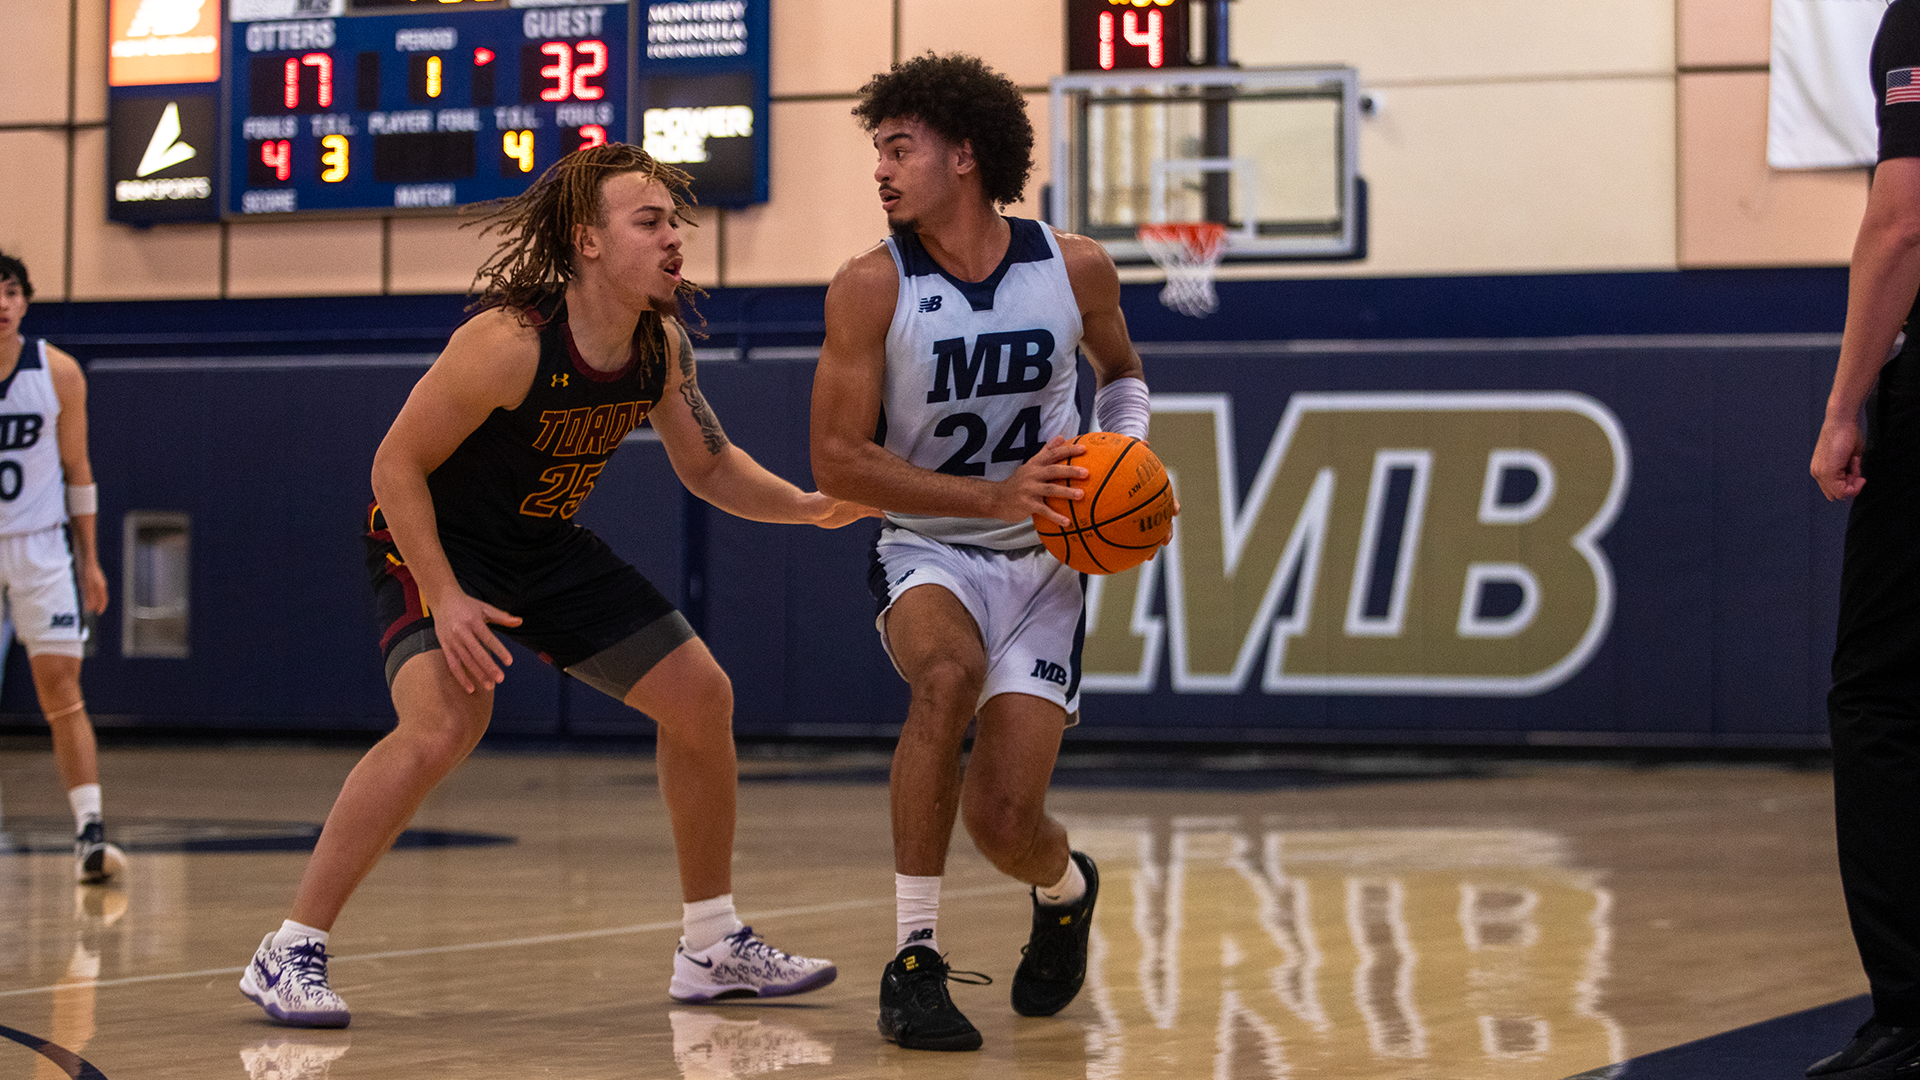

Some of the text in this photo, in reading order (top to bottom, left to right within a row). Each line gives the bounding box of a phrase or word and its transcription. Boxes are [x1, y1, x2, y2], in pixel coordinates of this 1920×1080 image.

[523, 8, 606, 39] GUEST
[648, 1, 748, 22] MONTEREY
[648, 21, 748, 43] PENINSULA
[247, 19, 336, 52] OTTERS
[647, 41, 747, 59] FOUNDATION
[1099, 8, 1163, 70] 14
[284, 52, 333, 109] 17
[426, 55, 442, 98] 1
[540, 40, 608, 102] 32
[243, 115, 298, 140] FOULS
[368, 110, 434, 134] PLAYER
[556, 102, 614, 127] FOULS
[643, 105, 754, 138] POWER
[261, 140, 291, 181] 4
[321, 134, 349, 183] 3
[503, 129, 534, 173] 4
[926, 328, 1055, 404] MB
[933, 405, 1046, 476] 24
[519, 459, 607, 520] 25
[1082, 390, 1631, 698] MB
[1030, 658, 1067, 686] MB
